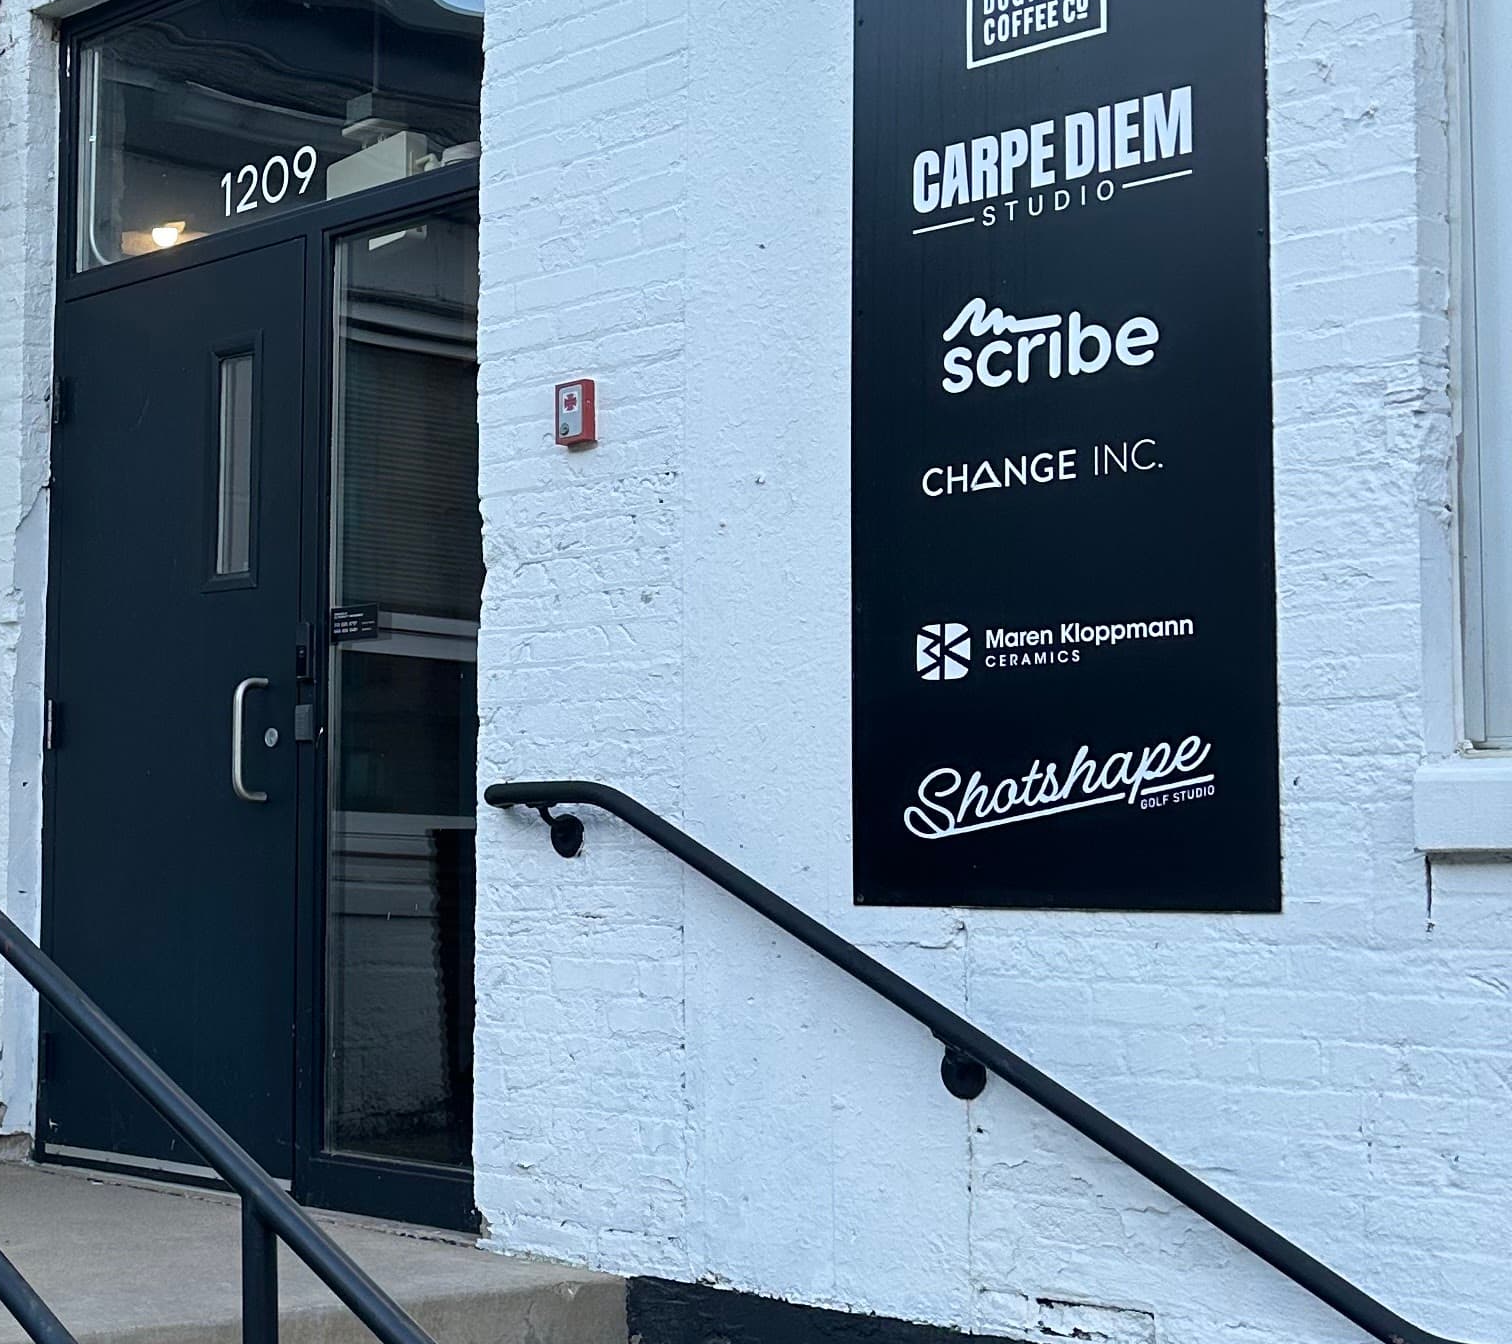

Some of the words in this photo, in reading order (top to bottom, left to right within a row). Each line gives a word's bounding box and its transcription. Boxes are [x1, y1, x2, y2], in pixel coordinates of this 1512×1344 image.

[983, 0, 1059, 46] COFFEE
[912, 119, 1056, 214] CARPE
[1064, 85, 1193, 181] DIEM
[220, 144, 318, 217] 1209
[982, 179, 1115, 227] STUDIO
[942, 298, 1160, 394] scribe
[921, 448, 1078, 498] CHANGE
[1094, 438, 1165, 476] INC.
[984, 649, 1082, 668] CERAMICS
[985, 628, 1054, 649] Maren
[1060, 618, 1195, 646] Kloppmann
[903, 735, 1216, 840] Shotshape
[1140, 794, 1170, 810] GOLF
[1172, 784, 1216, 804] STUDIO
